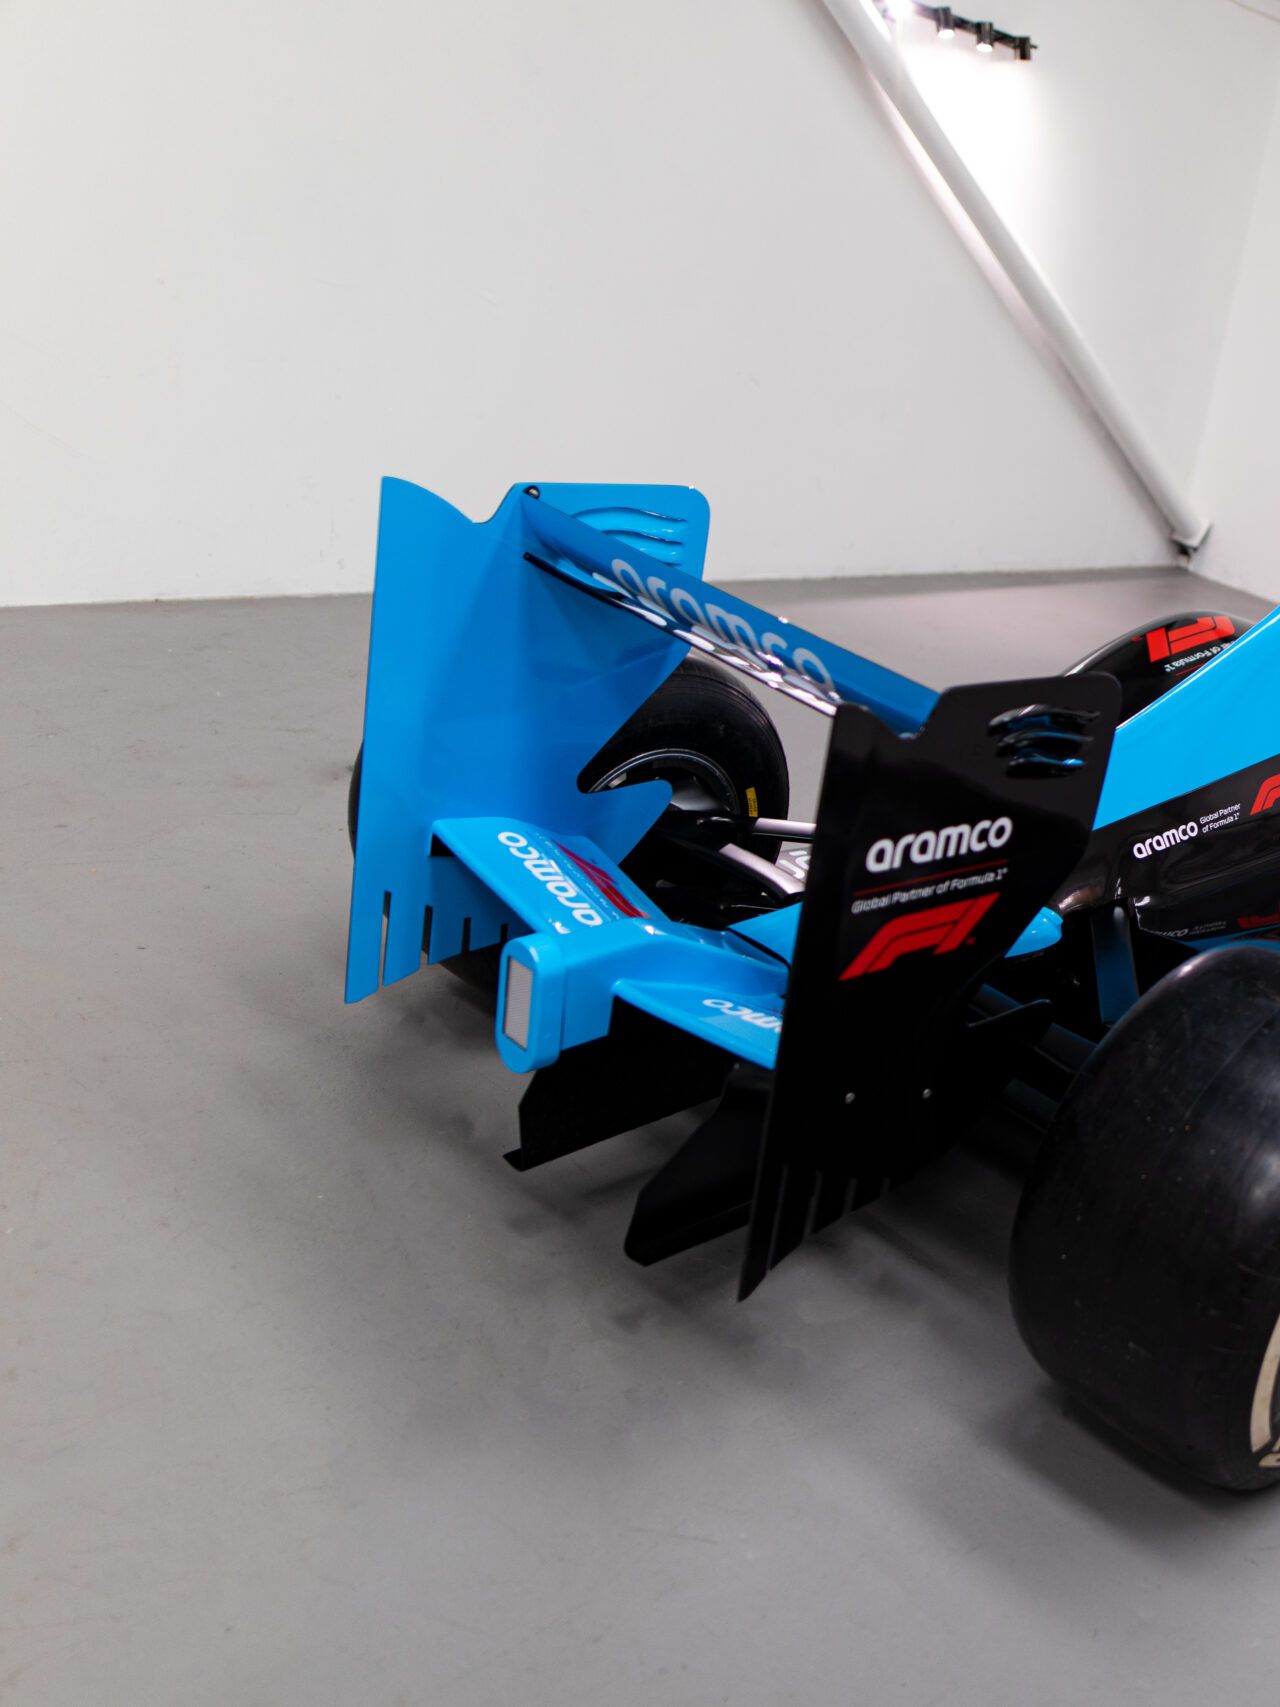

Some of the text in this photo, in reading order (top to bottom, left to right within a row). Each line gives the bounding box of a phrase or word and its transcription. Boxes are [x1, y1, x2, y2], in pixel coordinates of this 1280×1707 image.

[611, 558, 842, 702] aramco
[1172, 650, 1211, 667] Formula
[1199, 802, 1241, 824] Global Partner
[1202, 823, 1210, 833] of
[1210, 816, 1235, 831] Formula
[866, 816, 1013, 873] aramco
[1132, 821, 1199, 859] aramco
[497, 831, 603, 926] aramco
[851, 894, 891, 915] Global
[891, 885, 935, 904] Partner
[936, 881, 949, 894] of
[950, 872, 998, 891] Formula
[839, 891, 1001, 981] F1
[702, 998, 783, 1034] mco
